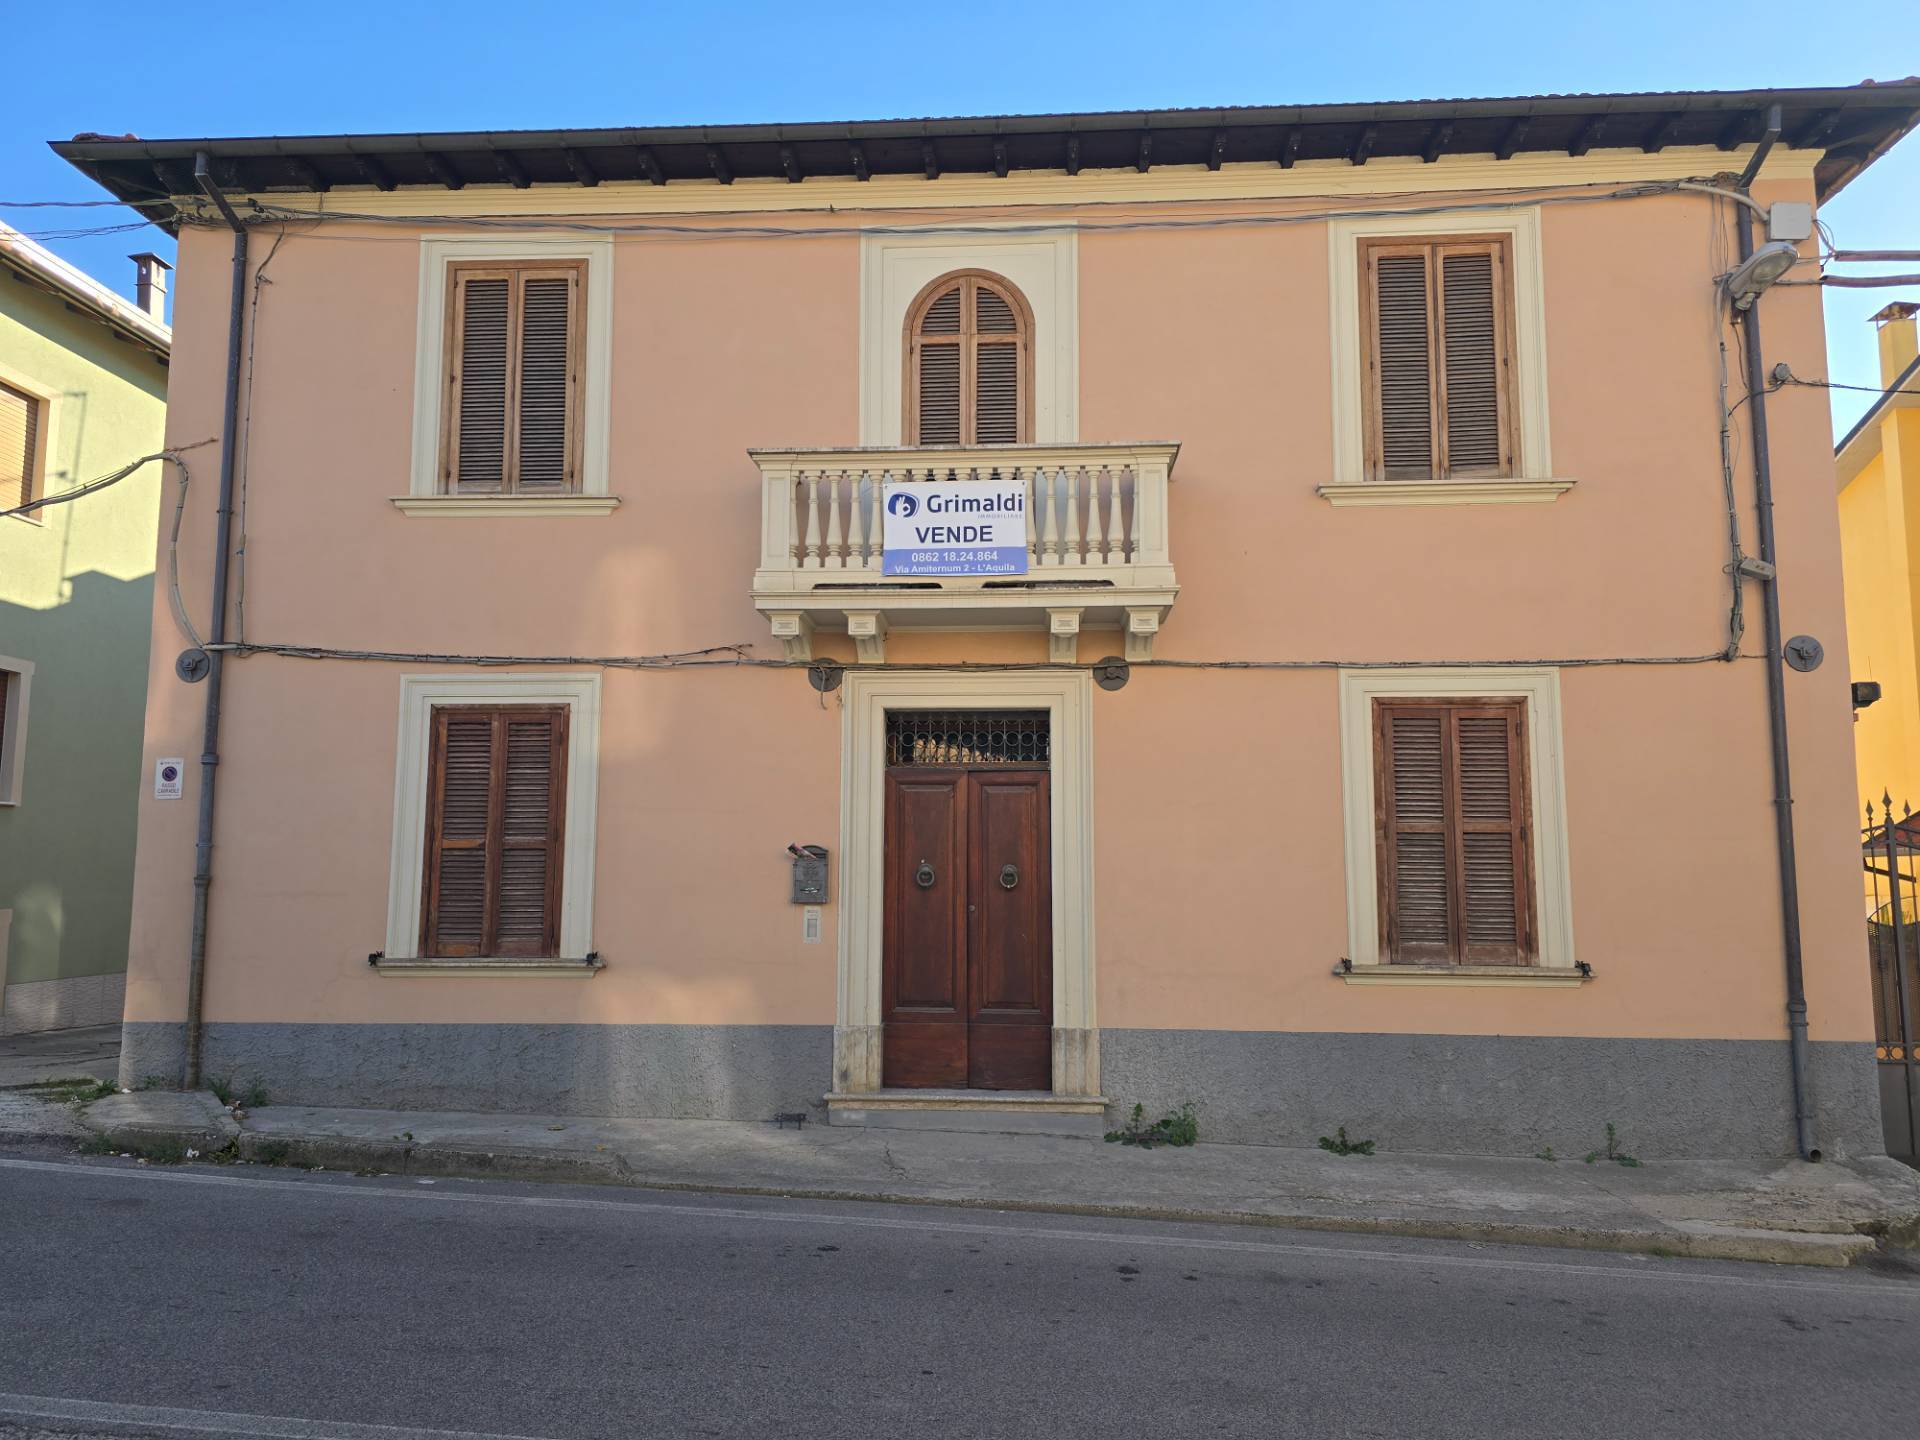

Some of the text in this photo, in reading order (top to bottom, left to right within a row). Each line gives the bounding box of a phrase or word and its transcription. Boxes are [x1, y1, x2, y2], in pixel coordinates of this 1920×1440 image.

[927, 494, 1023, 513] Grimaldi
[915, 525, 993, 543] VENDE
[911, 551, 998, 562] 0862 18.24.864
[895, 565, 910, 574] Via
[977, 563, 1015, 573] L'Aquila
